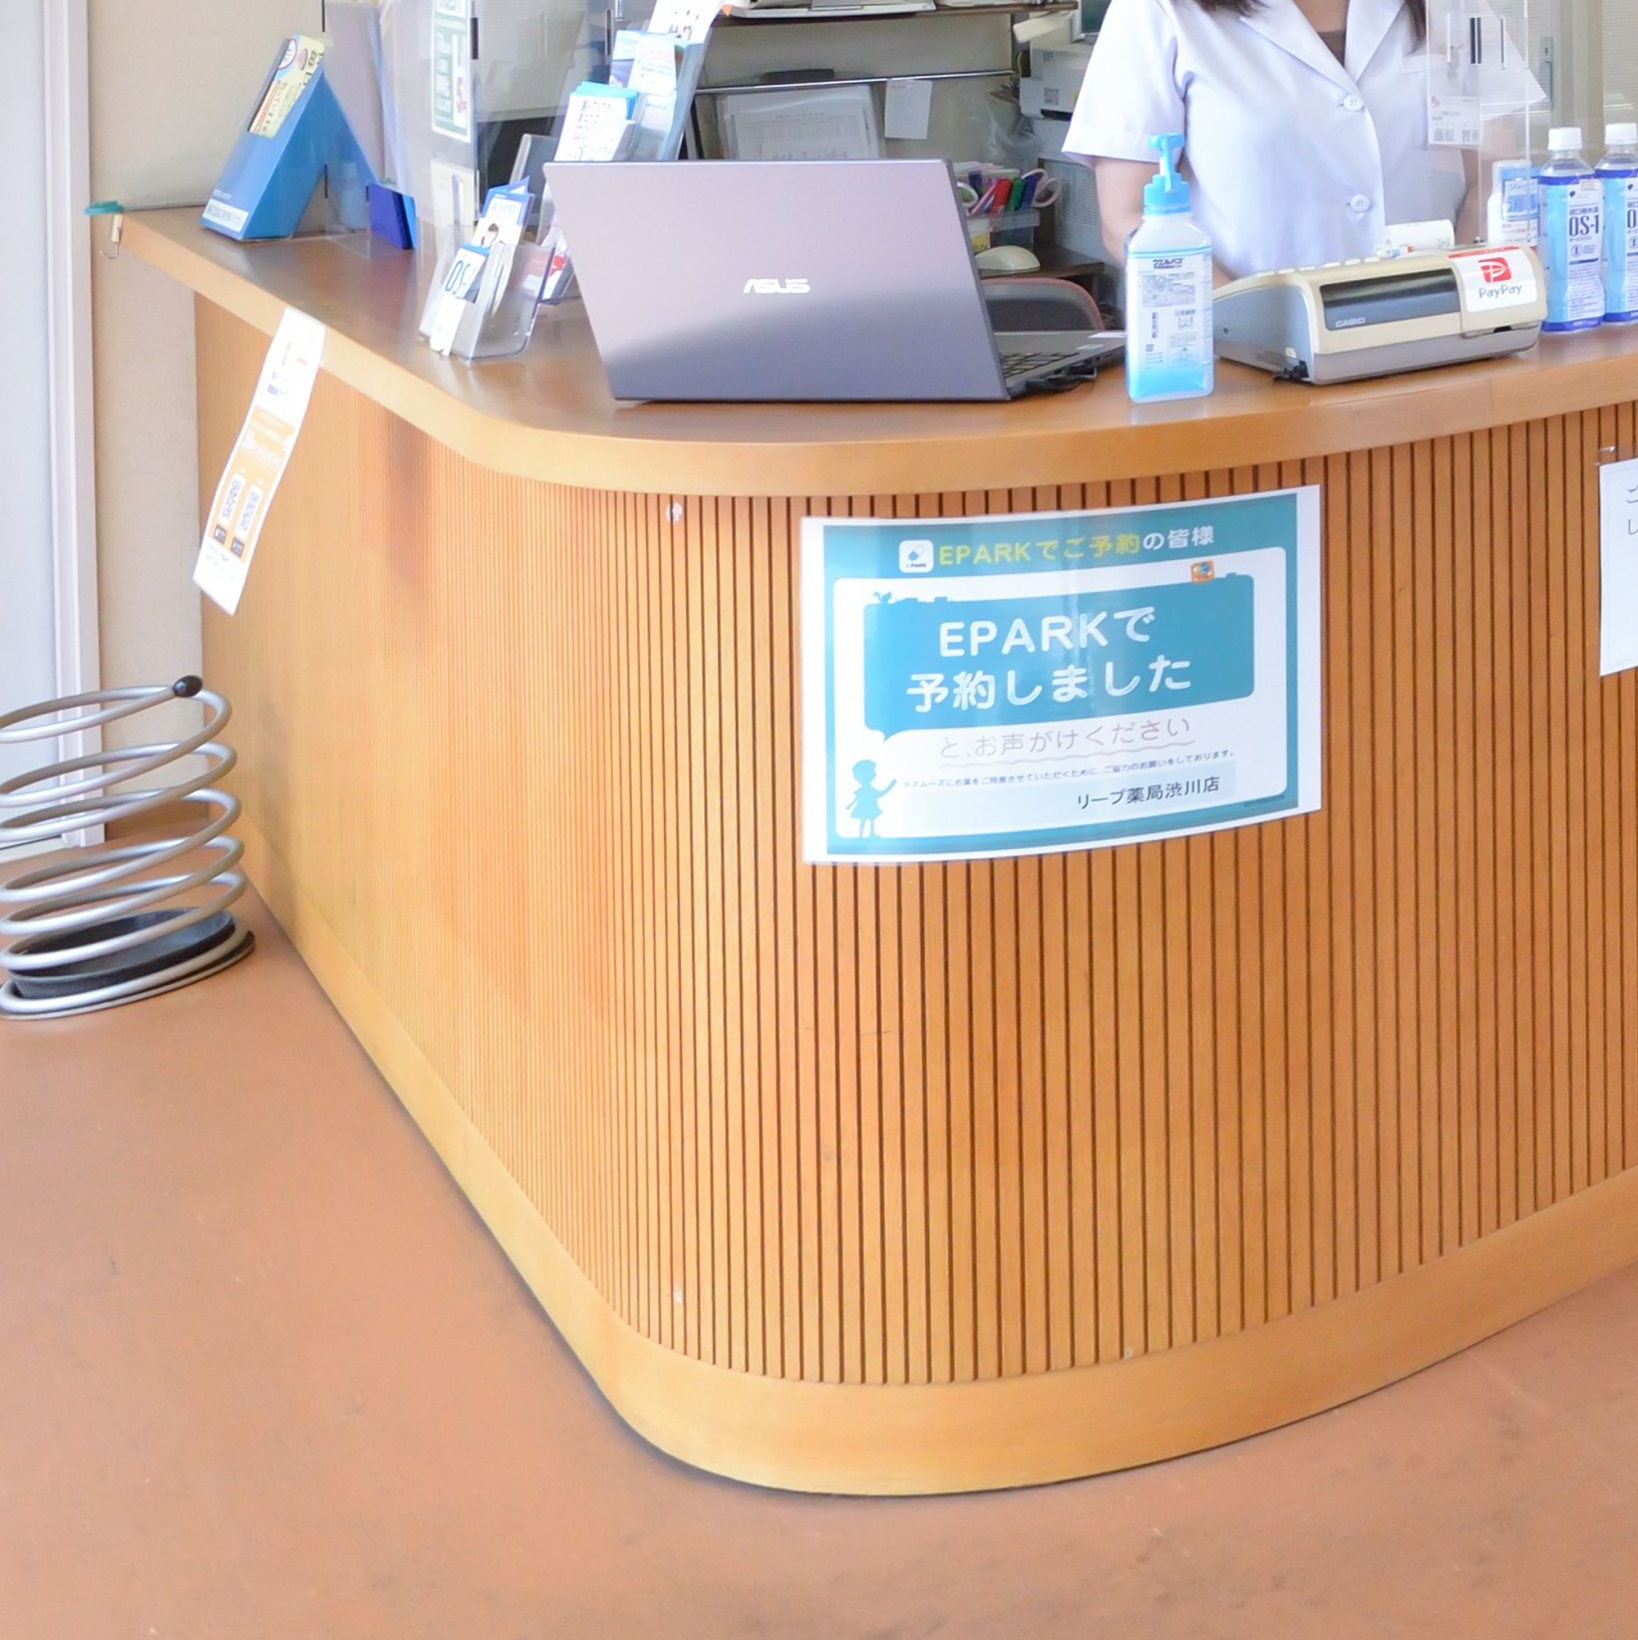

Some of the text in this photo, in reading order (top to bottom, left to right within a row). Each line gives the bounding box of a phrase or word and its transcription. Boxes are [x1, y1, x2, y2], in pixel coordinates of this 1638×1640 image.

[1569, 214, 1599, 237] OS-1
[743, 278, 811, 294] ASUS
[1479, 284, 1522, 299] PayPay
[1335, 316, 1366, 328] CASIO
[939, 525, 1215, 565] EPARKでご予約の皆様
[939, 606, 1156, 657] EPARKで
[907, 654, 1191, 713] 予約しました
[940, 717, 1190, 759] と、お声がけください
[1078, 776, 1221, 810] リープ薬局渋川店
